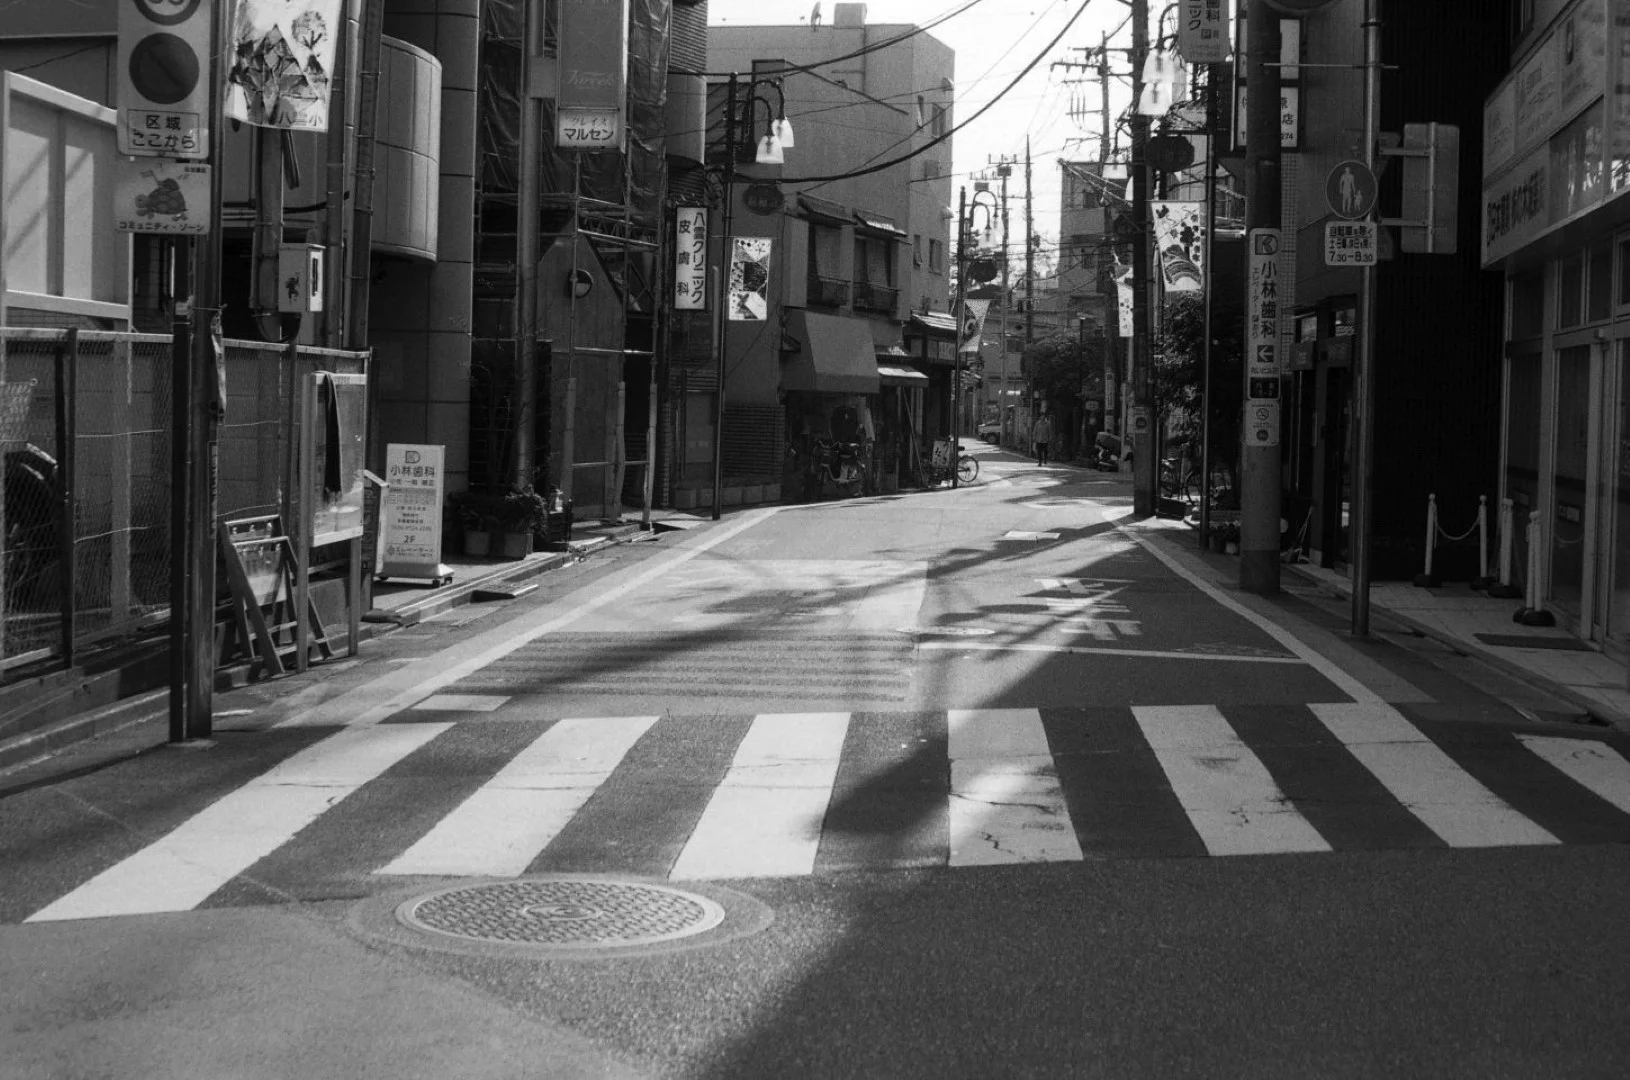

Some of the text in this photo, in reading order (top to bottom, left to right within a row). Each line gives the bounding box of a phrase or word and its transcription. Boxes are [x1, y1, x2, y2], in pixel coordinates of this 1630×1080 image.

[146, 115, 181, 131] 区域
[132, 132, 195, 149] ここから
[563, 128, 614, 141] マルセン
[677, 219, 691, 296] 皮膚科
[1260, 260, 1277, 340] 小林歯科
[390, 465, 435, 477] 小林歯科
[404, 535, 416, 544] 2F
